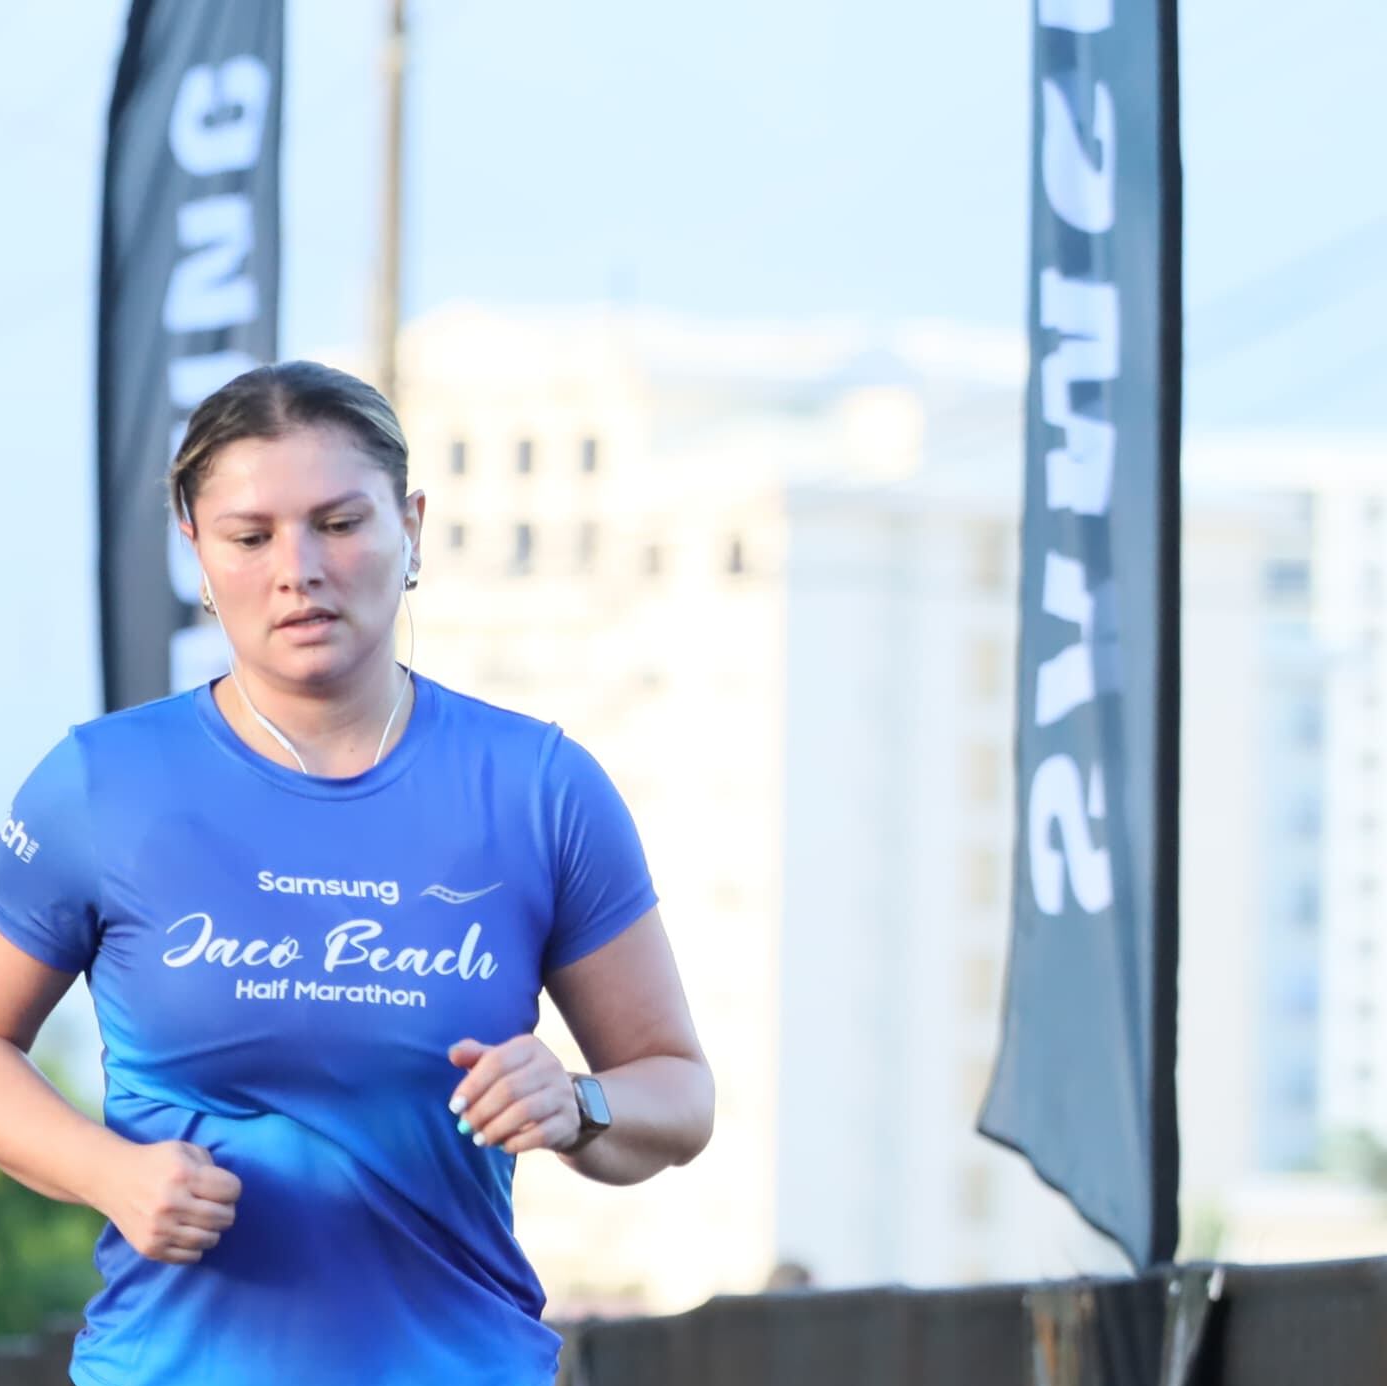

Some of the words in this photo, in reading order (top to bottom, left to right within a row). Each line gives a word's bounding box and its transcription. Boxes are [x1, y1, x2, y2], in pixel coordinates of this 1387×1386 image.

[258, 871, 399, 905] Samsung
[324, 919, 498, 981] Beach
[235, 979, 289, 1001] Half
[294, 981, 427, 1008] Marathon
